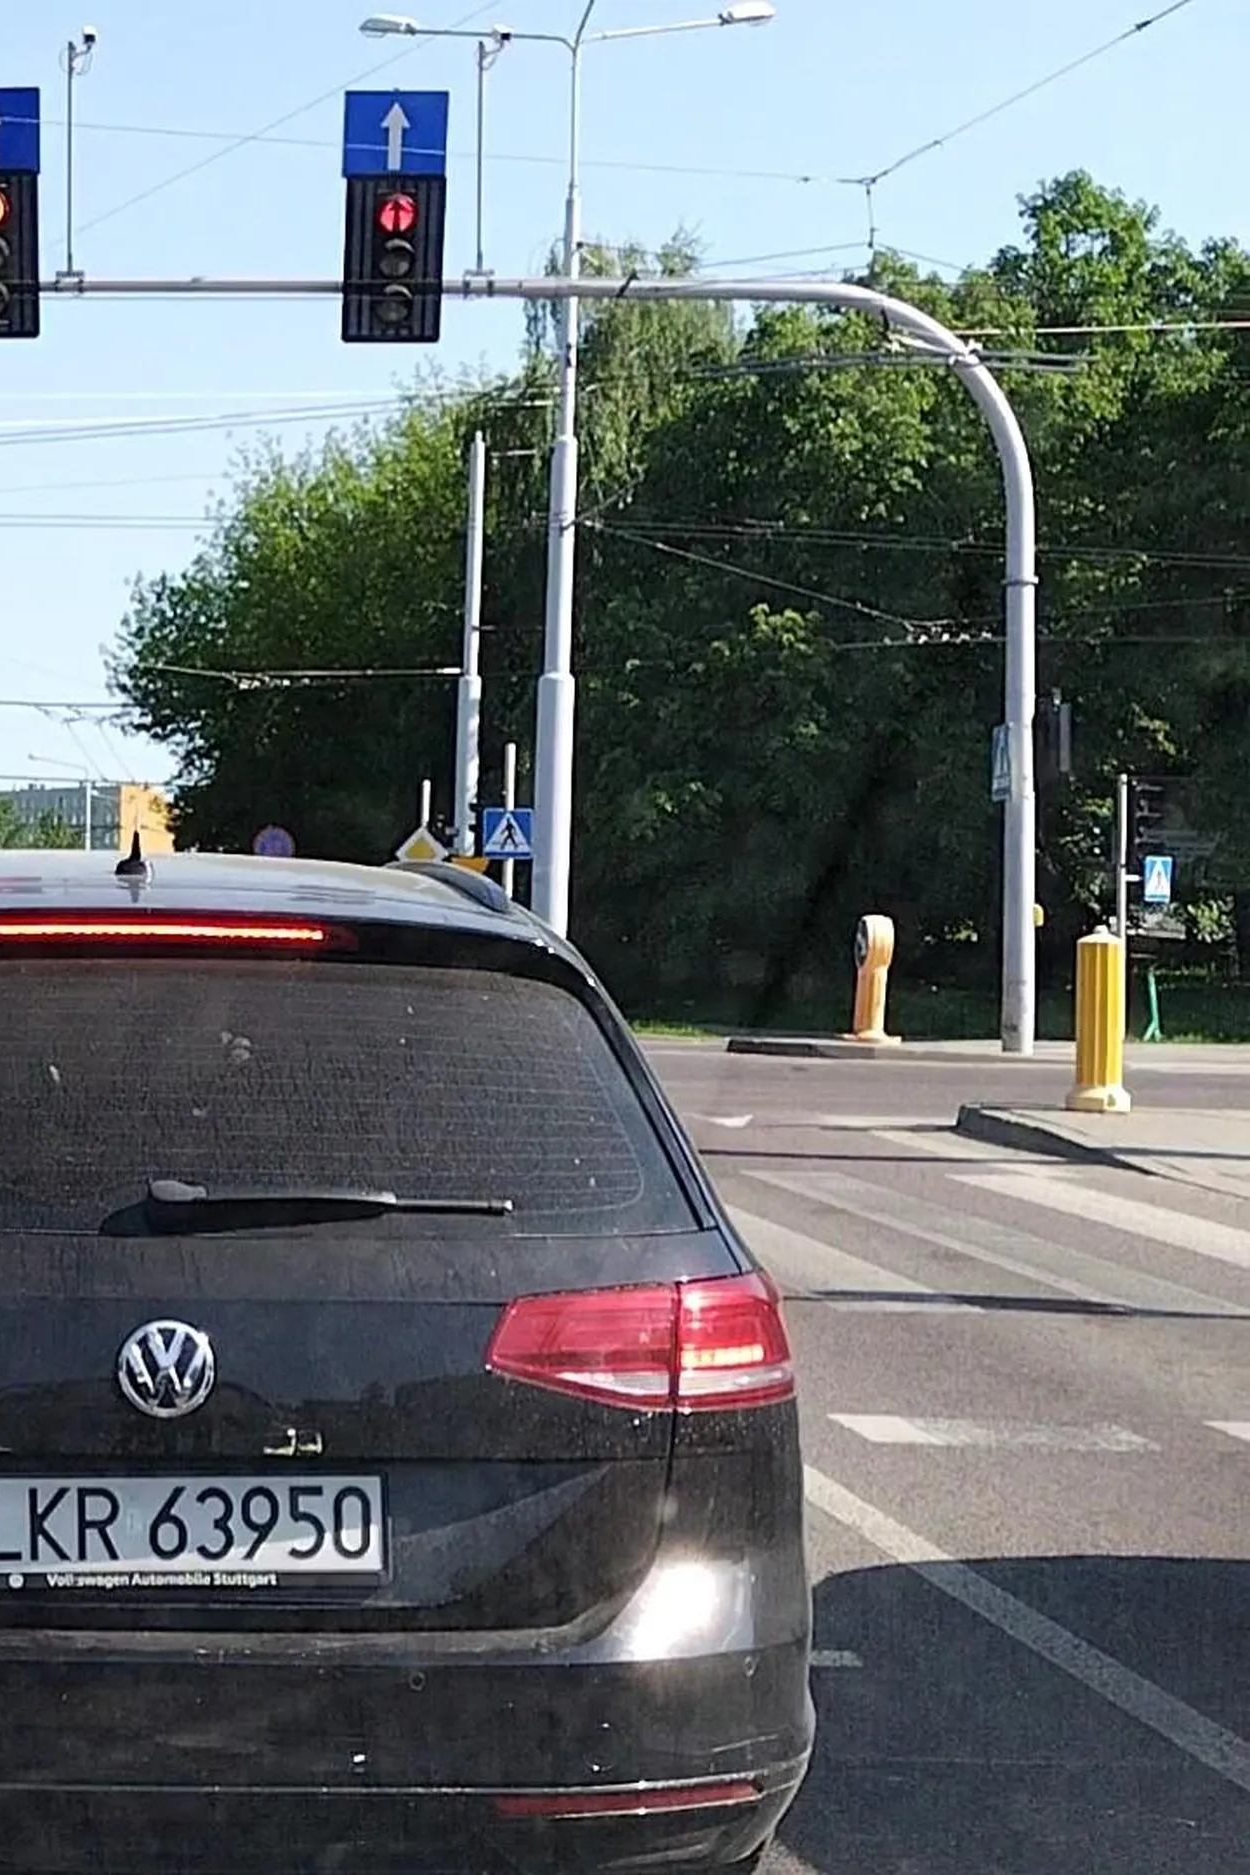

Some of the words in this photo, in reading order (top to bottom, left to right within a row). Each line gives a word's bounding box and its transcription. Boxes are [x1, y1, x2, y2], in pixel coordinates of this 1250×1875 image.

[117, 1319, 215, 1418] VW
[148, 1486, 372, 1561] 63950
[213, 1573, 277, 1588] Stuttgart
